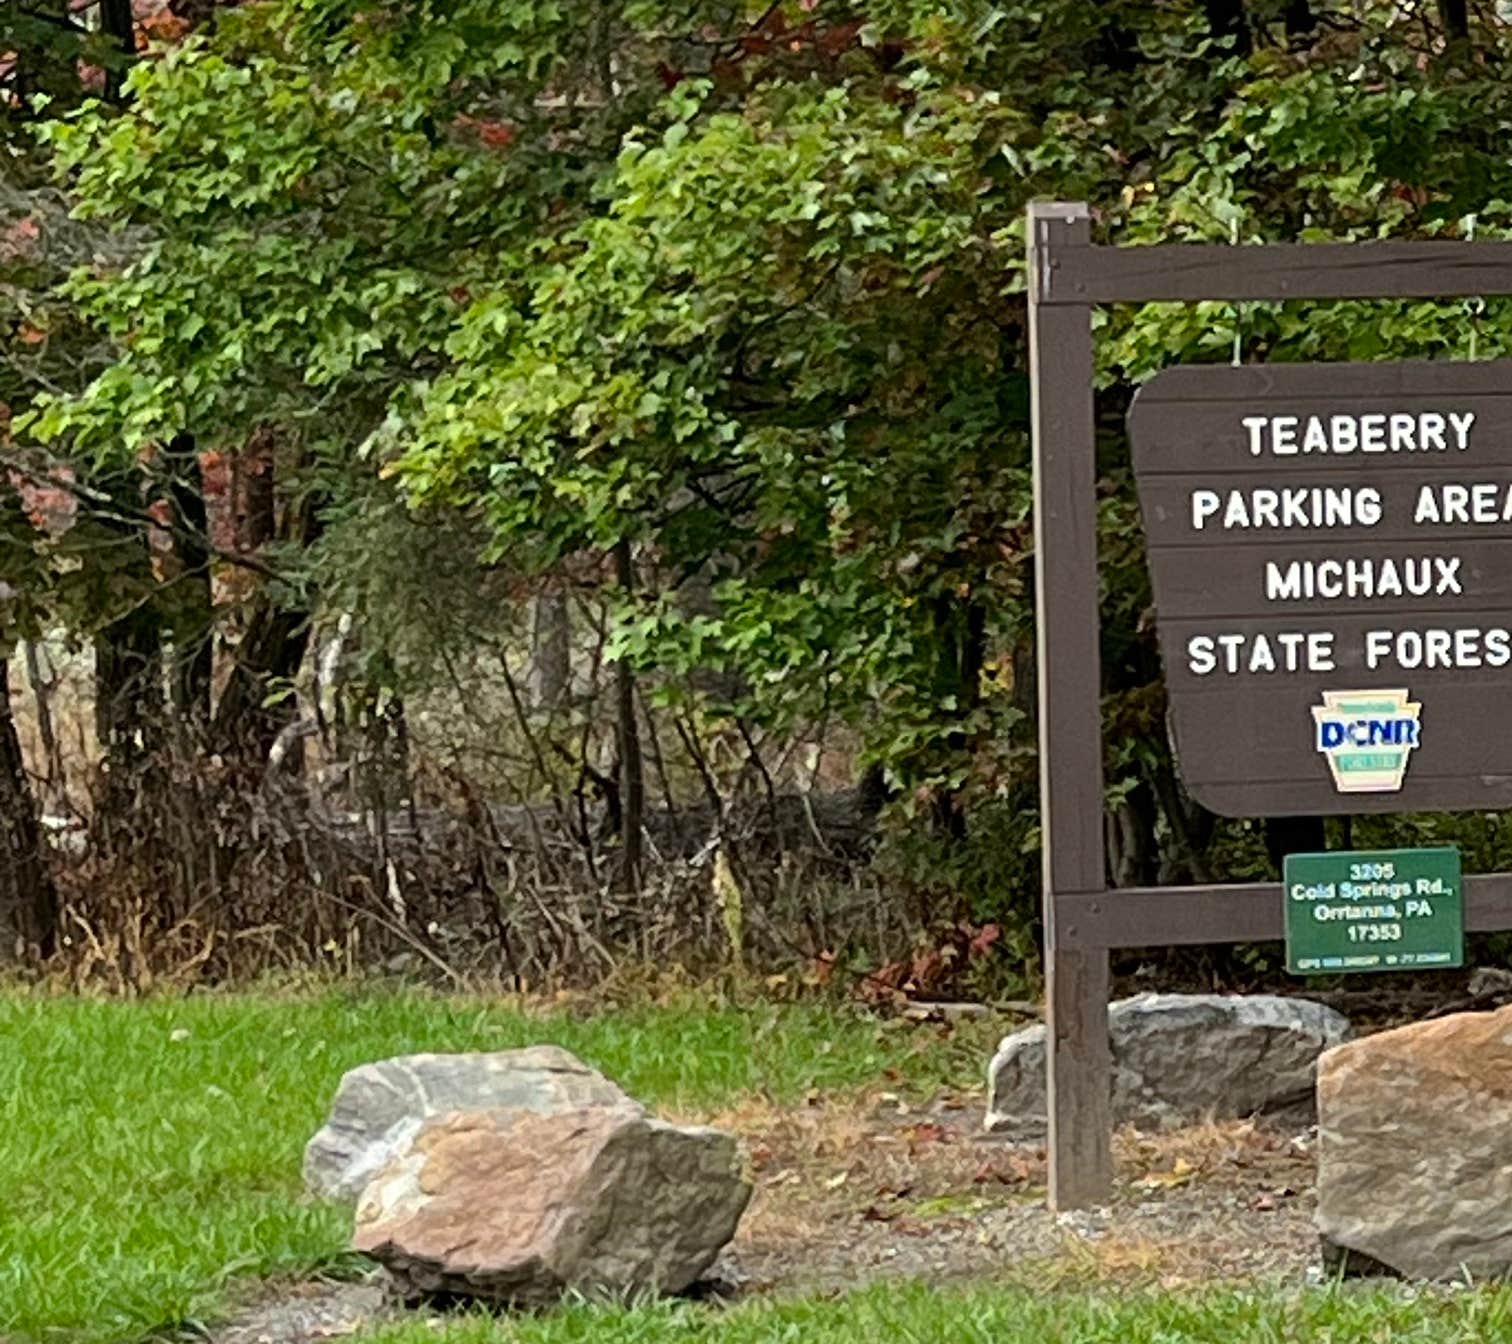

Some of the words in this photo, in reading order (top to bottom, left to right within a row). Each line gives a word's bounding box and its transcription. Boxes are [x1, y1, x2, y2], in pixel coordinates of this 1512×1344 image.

[1243, 413, 1475, 455] TEABERRY
[1192, 488, 1382, 529] PARKING
[1266, 558, 1462, 600] MICHAUX
[1188, 633, 1335, 674] STATE
[1321, 719, 1416, 748] DCNR
[1350, 863, 1395, 881] 3205
[1291, 883, 1336, 900] Cold
[1339, 881, 1412, 900] Springs
[1405, 900, 1433, 917] PA
[1348, 924, 1401, 942] 17353
